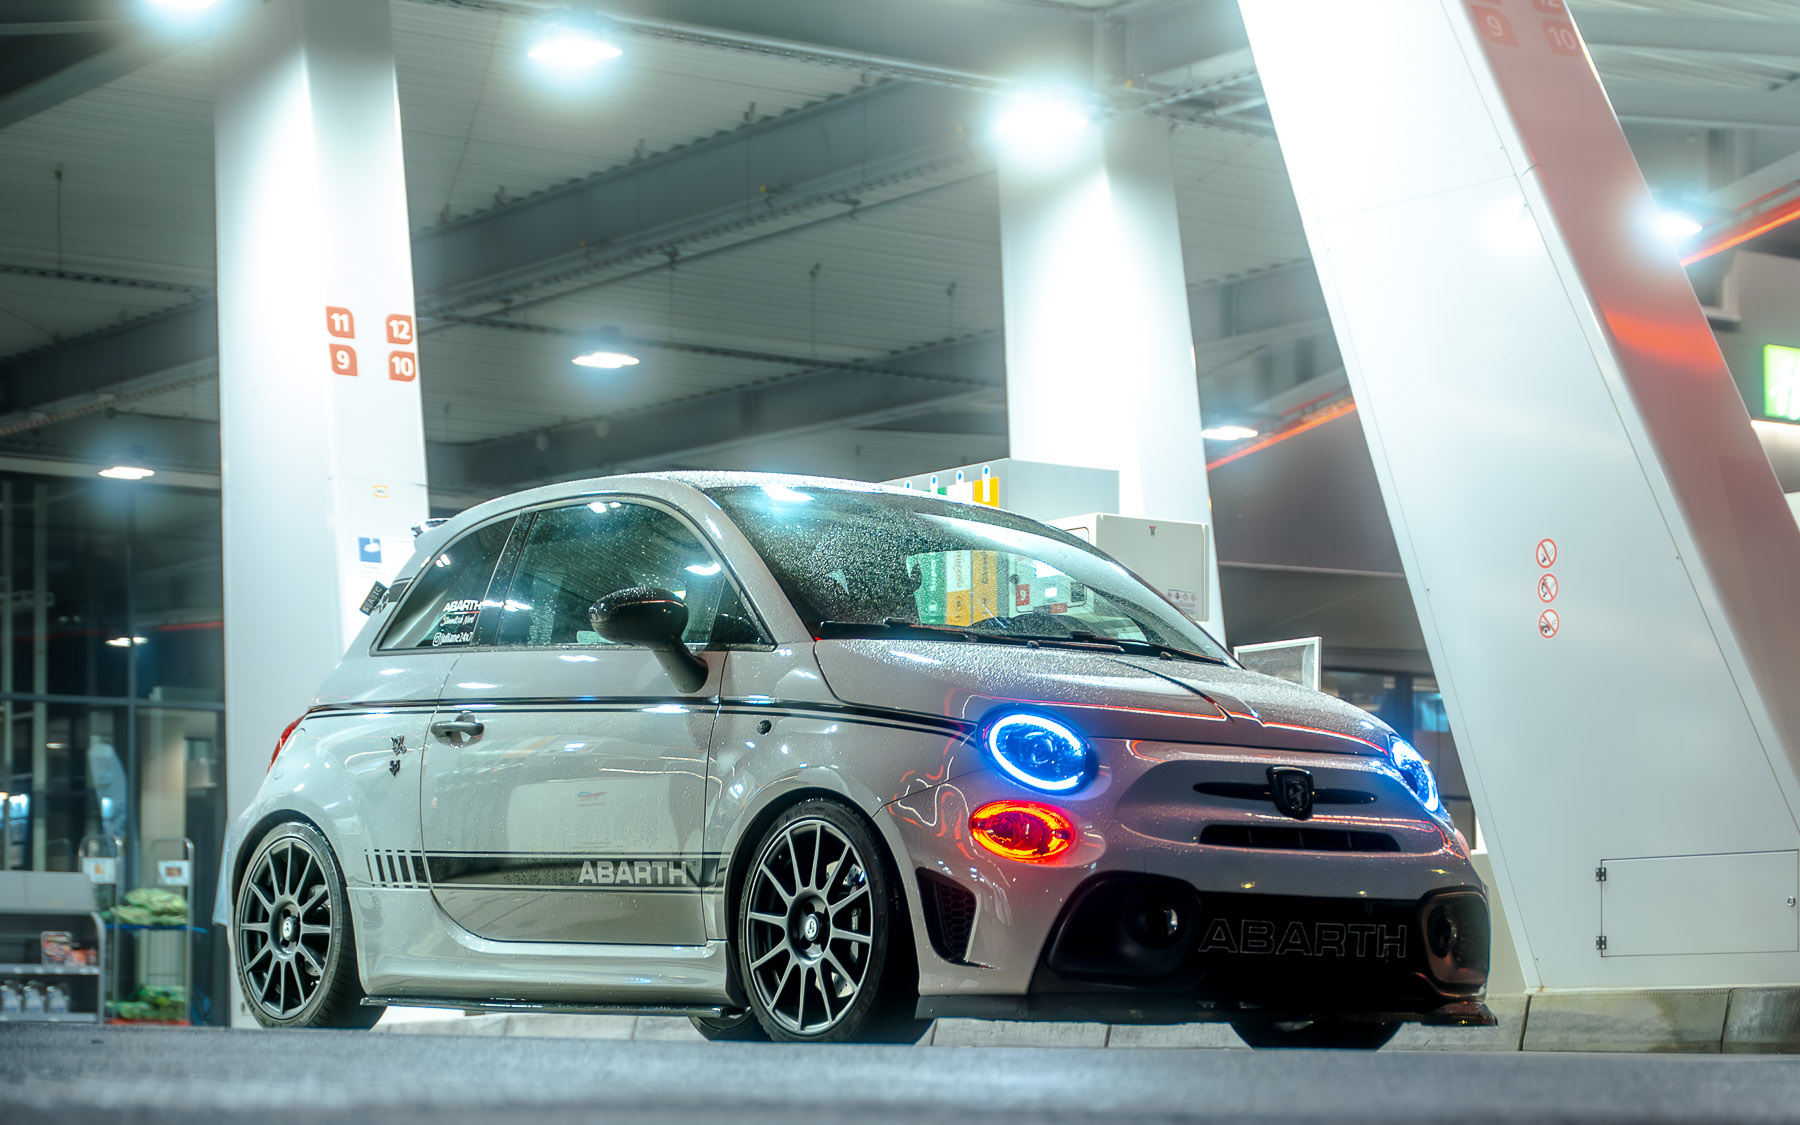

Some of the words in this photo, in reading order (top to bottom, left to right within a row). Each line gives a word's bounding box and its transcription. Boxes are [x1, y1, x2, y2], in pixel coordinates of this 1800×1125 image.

[1486, 15, 1504, 37] 9
[1548, 26, 1577, 50] 10
[330, 313, 349, 332] 11
[389, 319, 411, 339] 12
[336, 350, 349, 369] 9
[391, 356, 413, 376] 10
[442, 600, 482, 612] ABARTH
[578, 860, 688, 884] ABARTH
[1198, 918, 1407, 958] ABARTH
